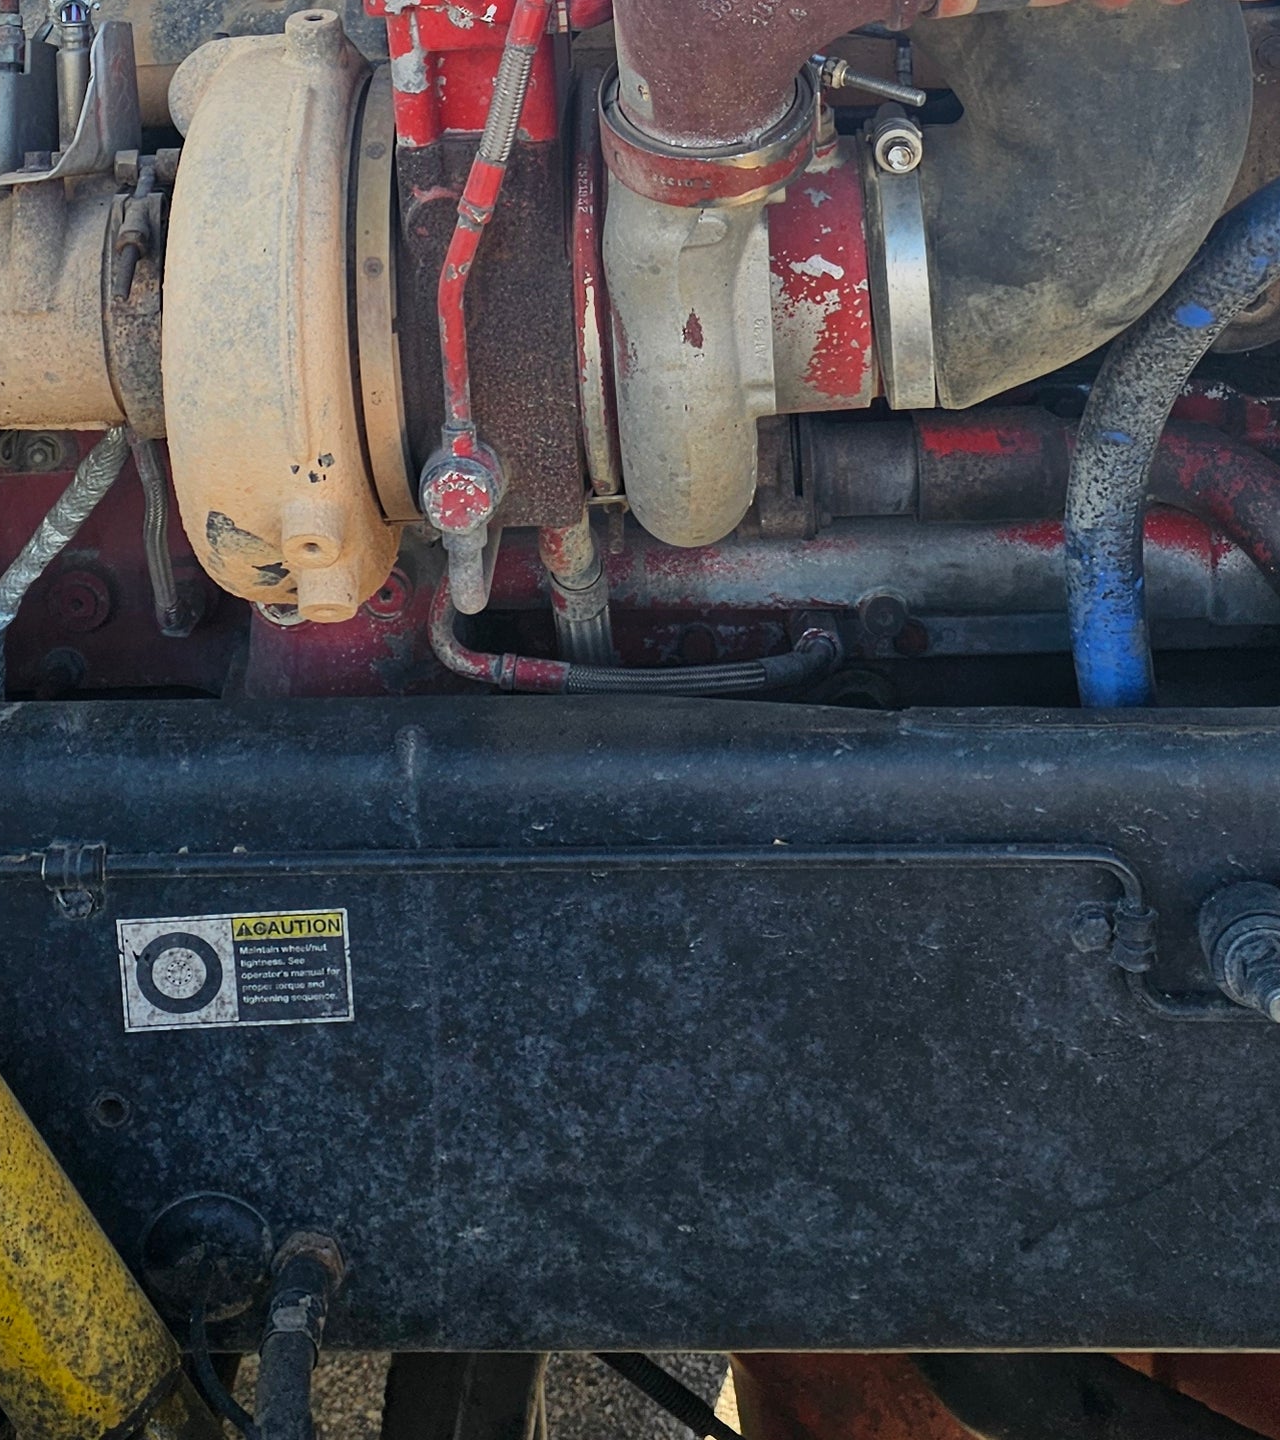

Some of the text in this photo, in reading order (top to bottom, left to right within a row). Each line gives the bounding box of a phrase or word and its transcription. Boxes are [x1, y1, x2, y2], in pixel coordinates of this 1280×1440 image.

[253, 918, 340, 936] CAUTION
[239, 946, 279, 955] Maintain
[287, 956, 306, 965] See
[241, 966, 341, 981] operator's manual for
[307, 979, 325, 989] and
[242, 994, 290, 1005] tightening
